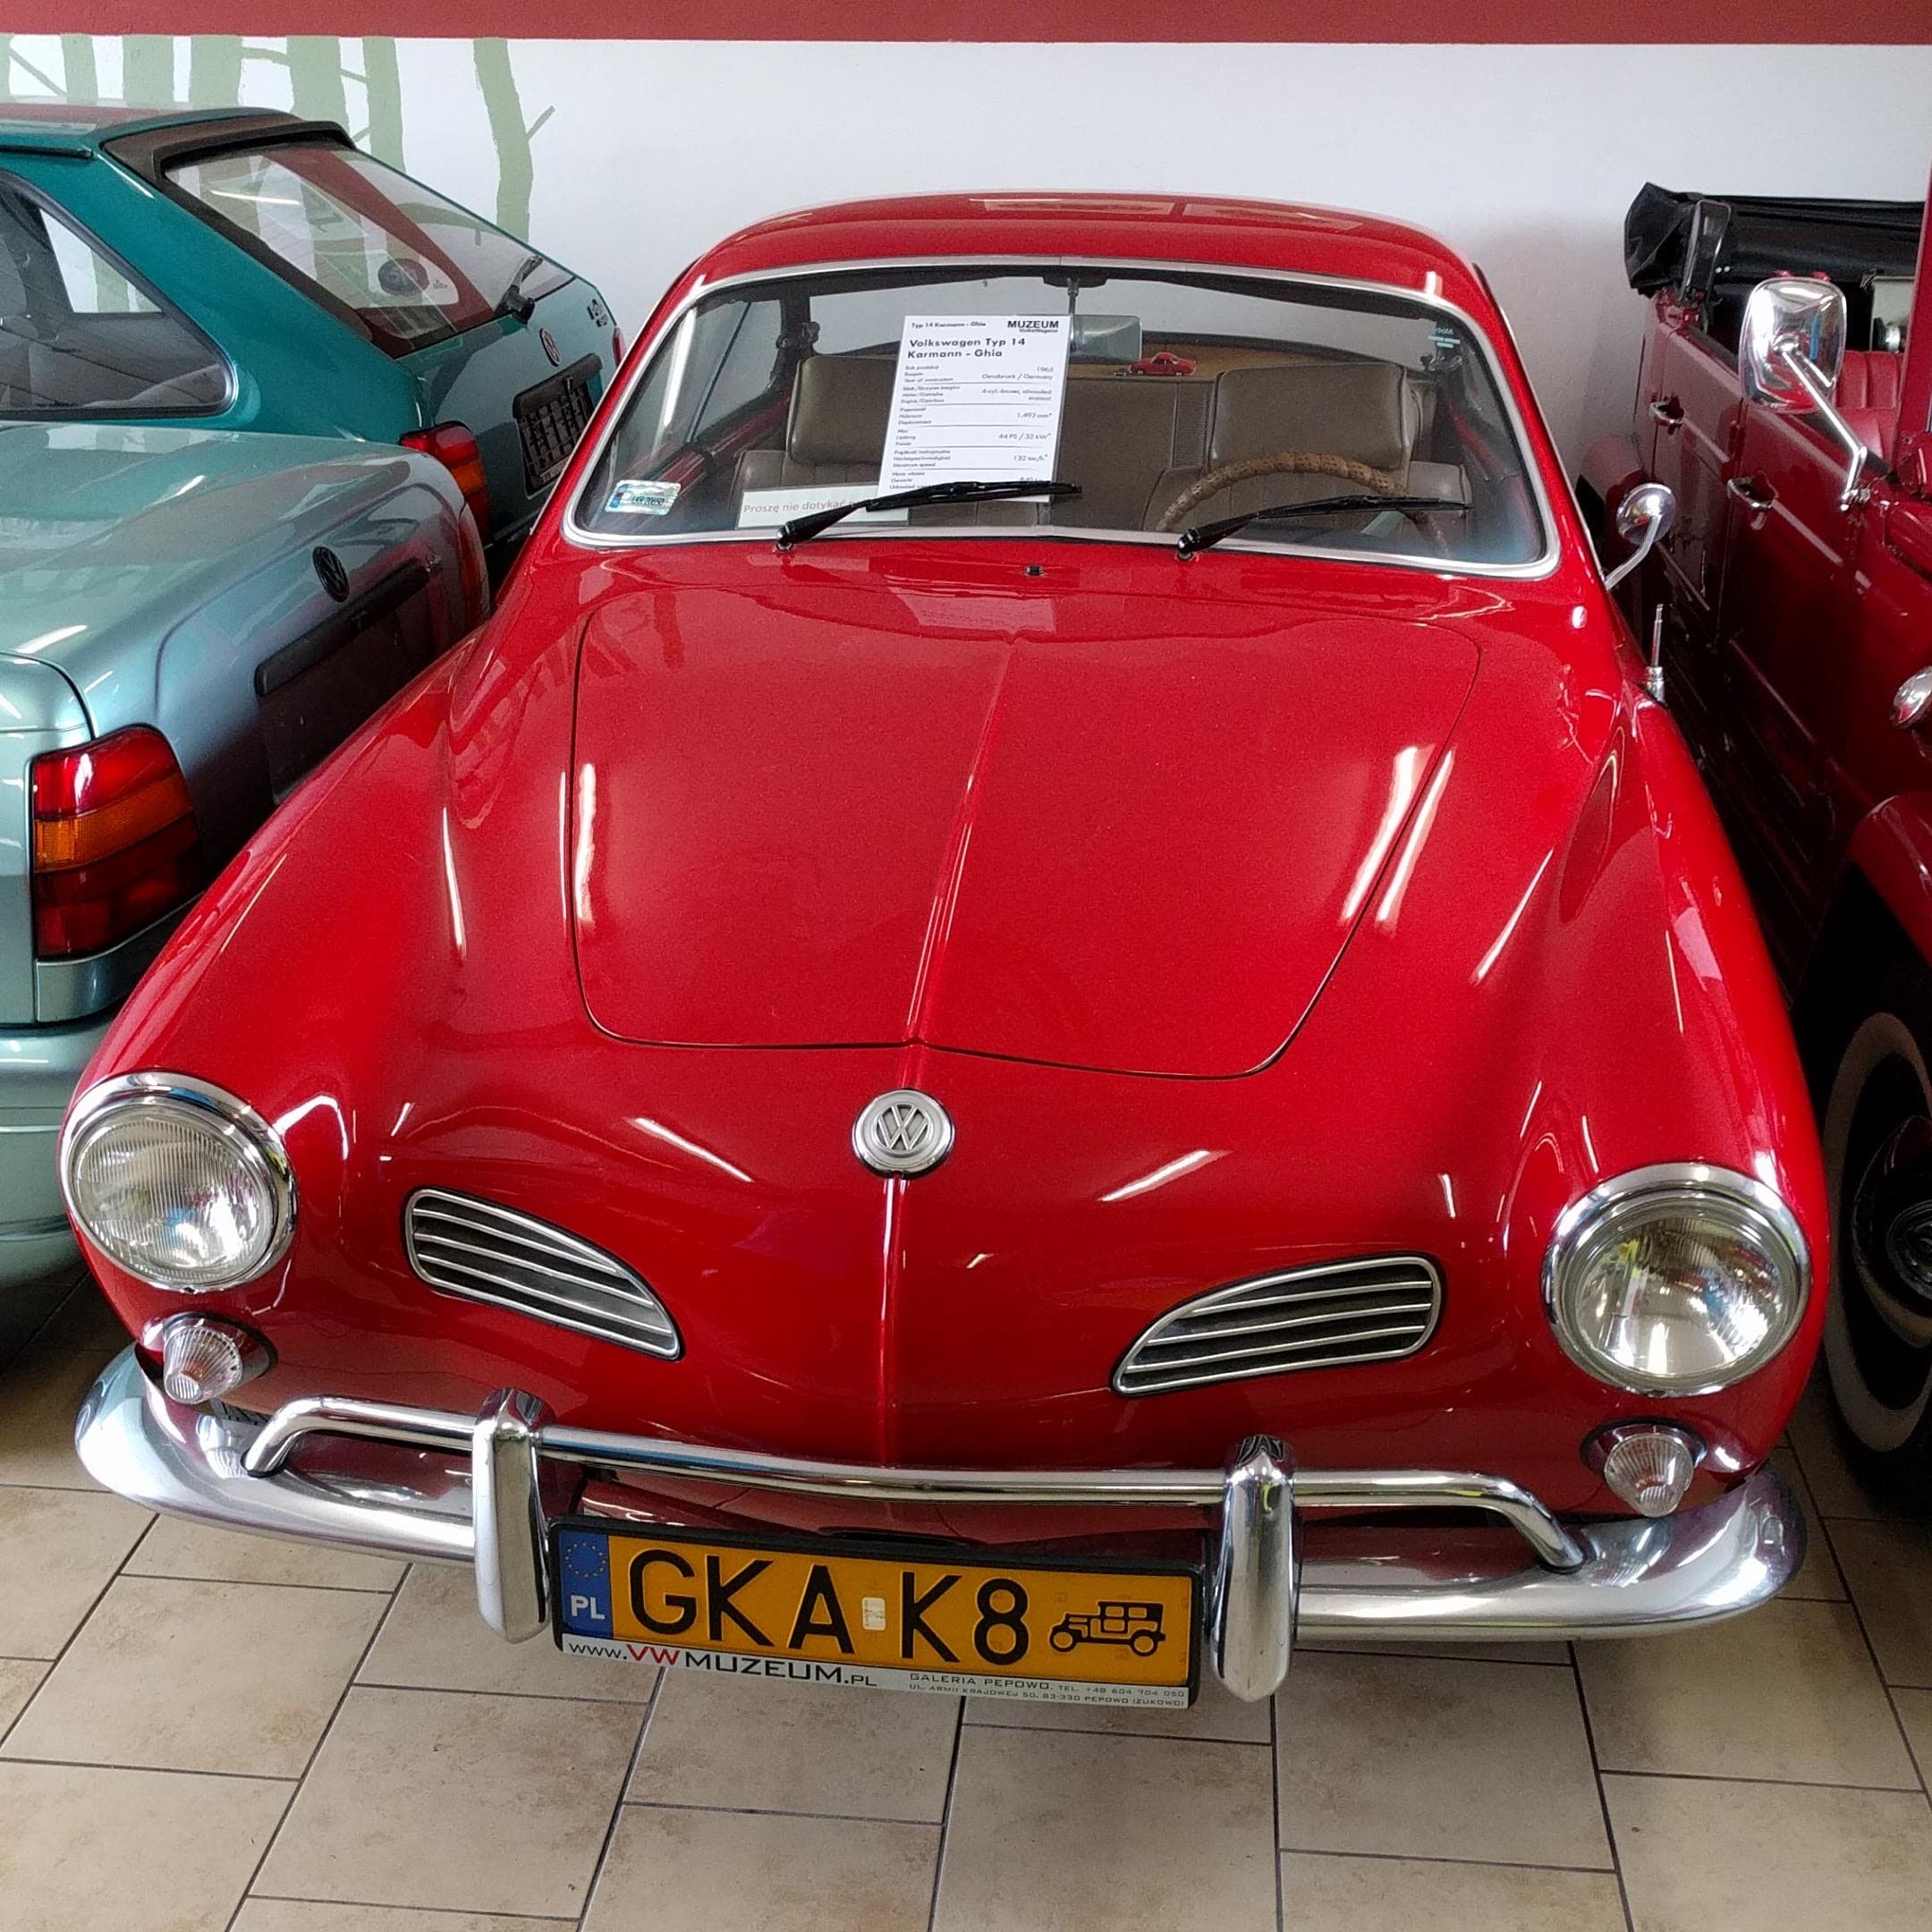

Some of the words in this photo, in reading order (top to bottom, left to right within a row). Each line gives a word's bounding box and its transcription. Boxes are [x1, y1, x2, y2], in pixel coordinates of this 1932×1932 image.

[1007, 320, 1059, 328] MUZEUM
[910, 339, 981, 348] Volkswagen
[986, 337, 1006, 347] Typ
[1012, 337, 1025, 345] 14
[907, 351, 962, 359] Karmann
[974, 349, 1003, 357] Ghia
[744, 504, 779, 513] Proszę
[783, 503, 799, 512] nie
[801, 499, 846, 512] dotykać
[571, 1595, 606, 1620] PL
[629, 1548, 855, 1654] GKA
[901, 1572, 1030, 1665] K8
[910, 1673, 977, 1685] GALERIA
[1059, 1684, 1080, 1692] TEL.
[962, 1688, 1019, 1697] KRAJOWEJ
[1084, 1695, 1130, 1704] PEPOWO
